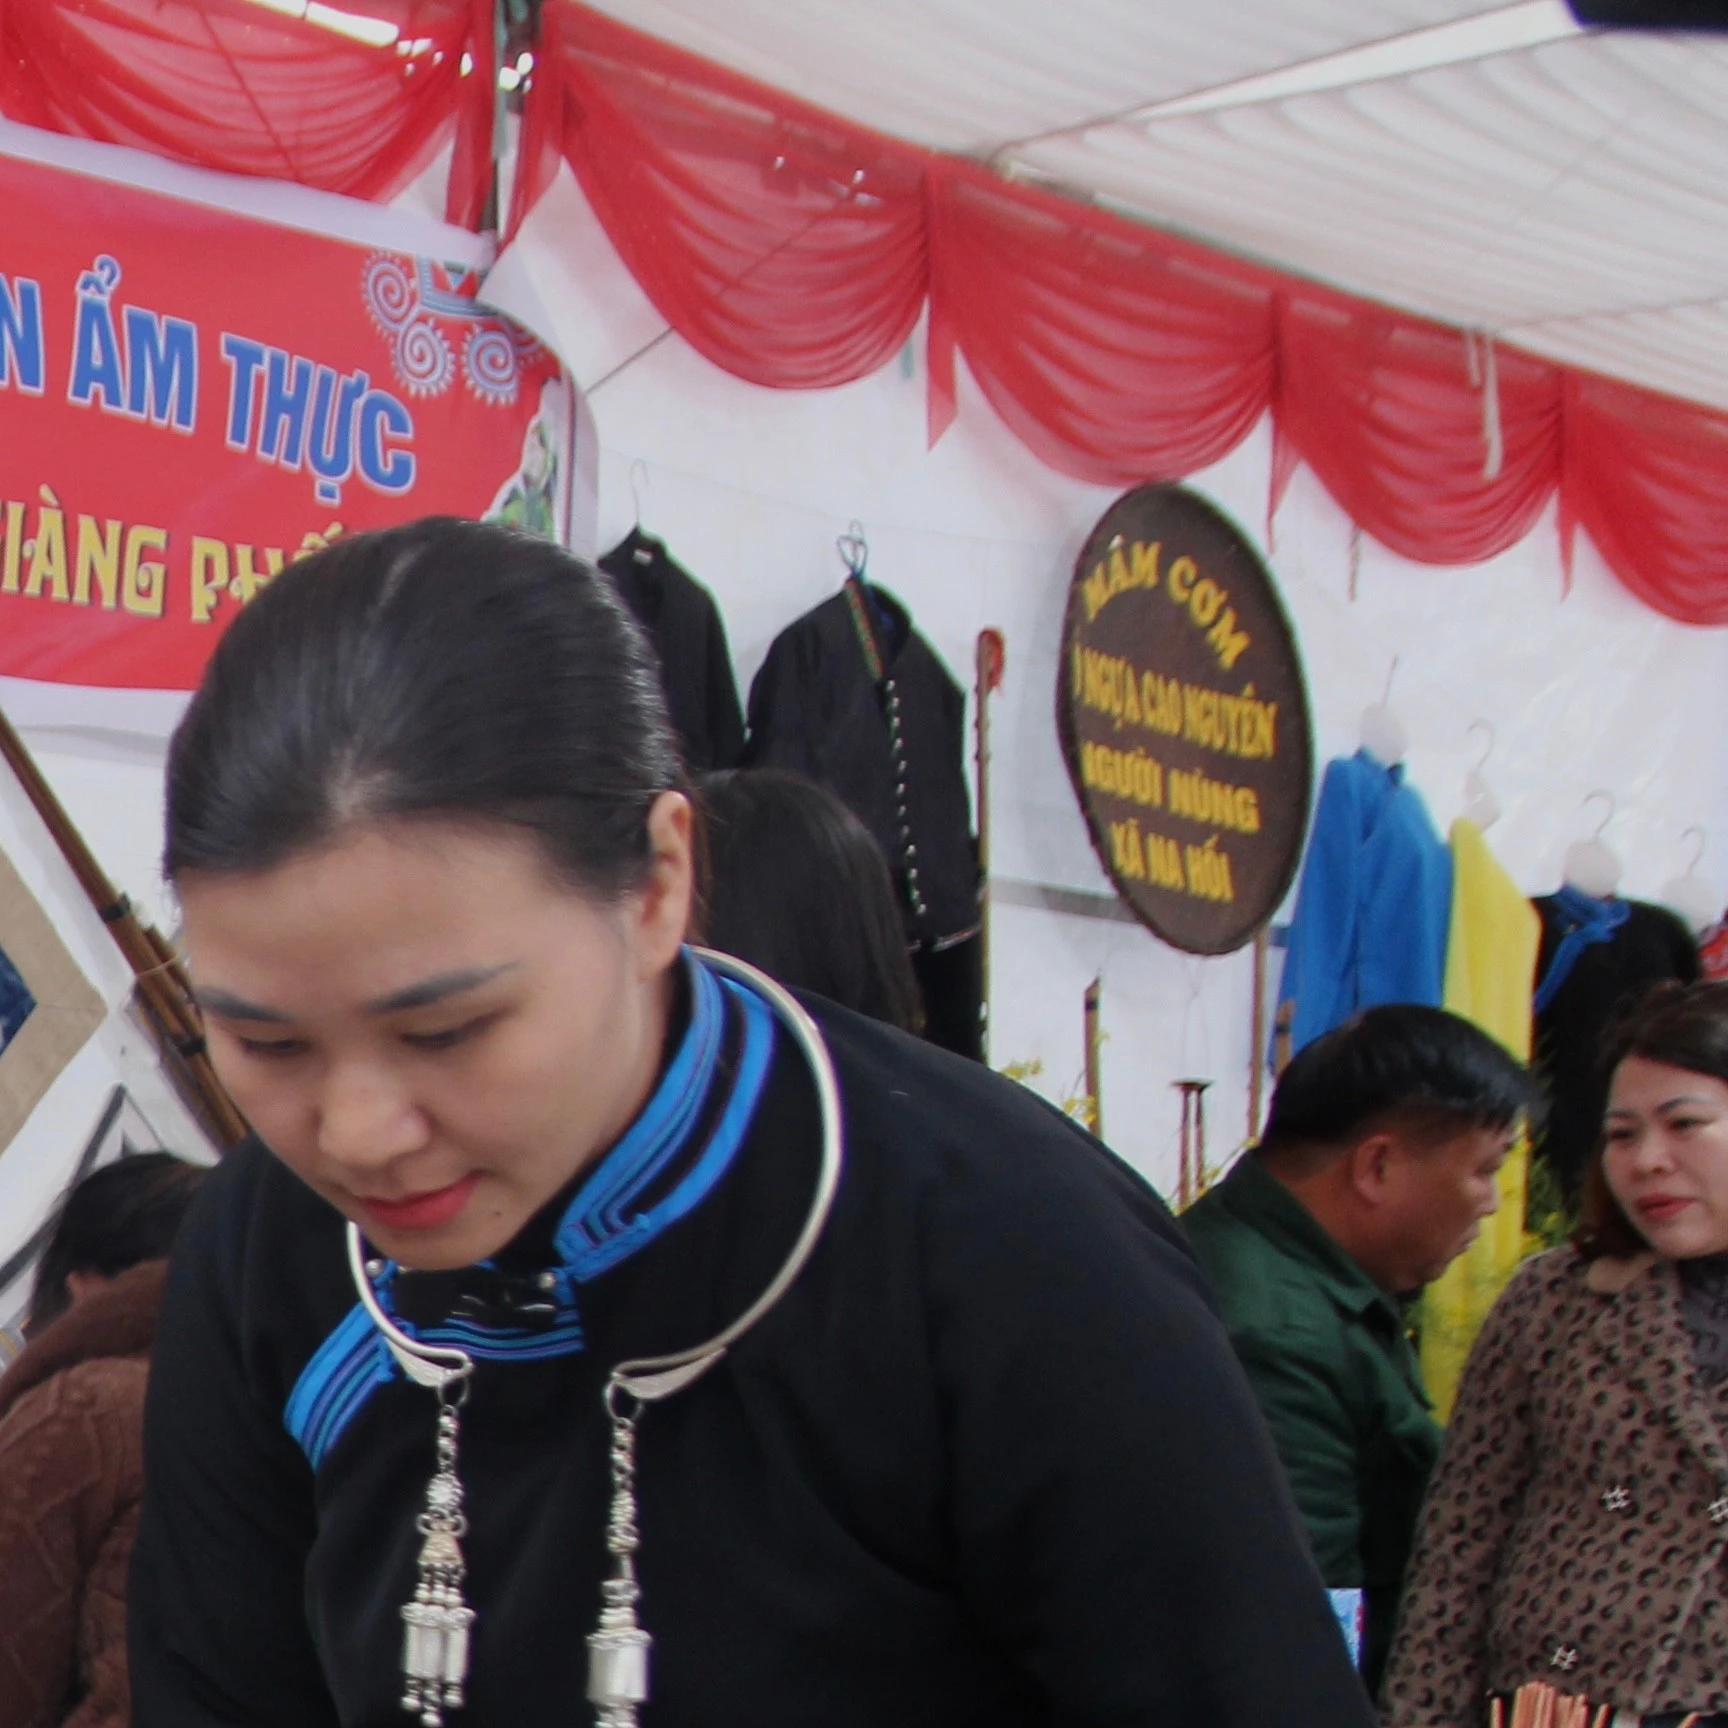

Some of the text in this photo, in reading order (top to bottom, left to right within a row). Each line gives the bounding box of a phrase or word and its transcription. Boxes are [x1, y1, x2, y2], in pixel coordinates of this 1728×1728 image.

[68, 255, 198, 434] ẨM
[221, 328, 416, 505] THỰC
[1082, 533, 1163, 625] MÂM
[1166, 555, 1253, 672] CƠM
